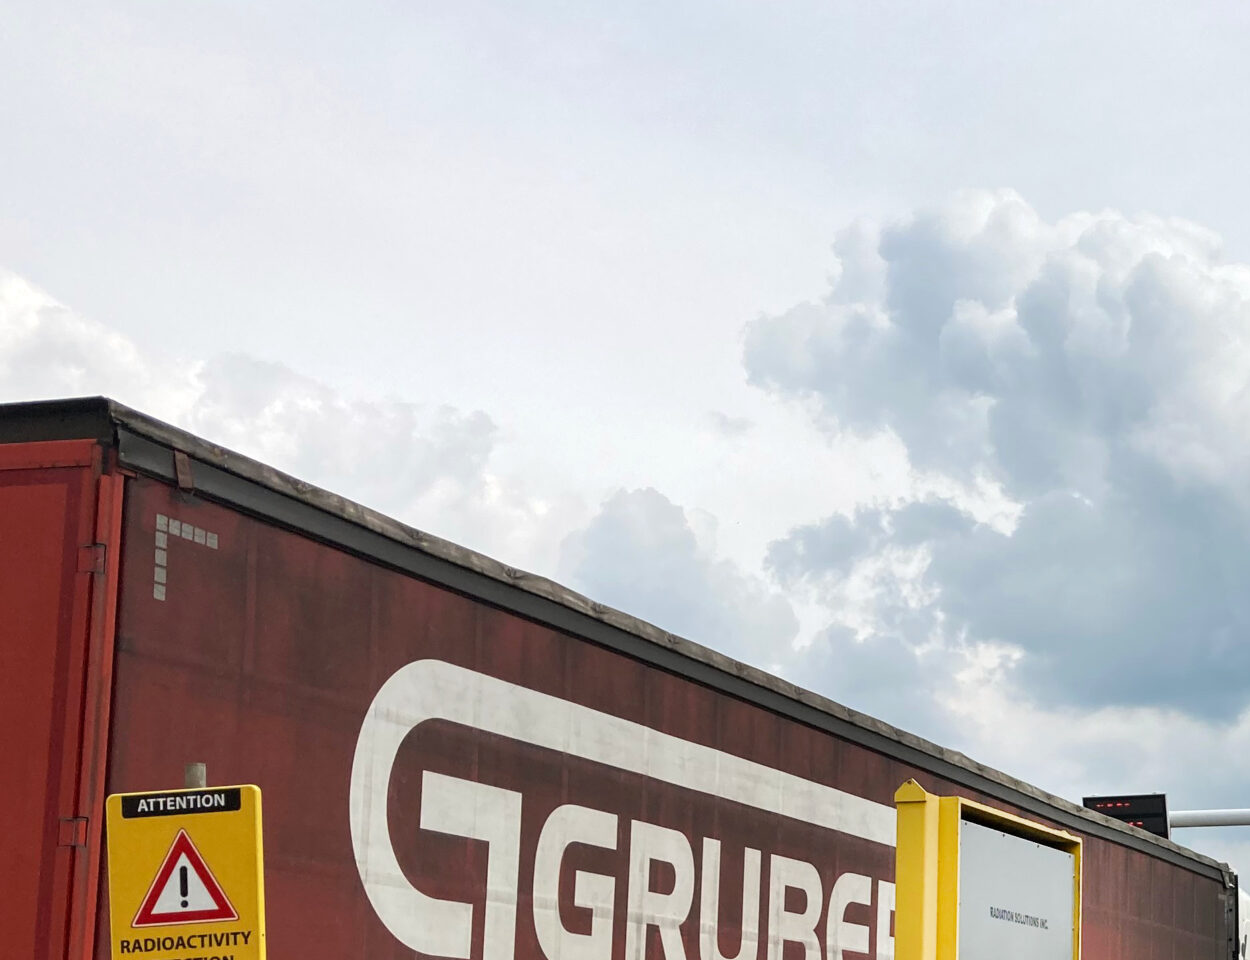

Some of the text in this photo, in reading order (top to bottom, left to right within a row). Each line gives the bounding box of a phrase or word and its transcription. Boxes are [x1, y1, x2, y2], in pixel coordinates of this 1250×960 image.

[137, 793, 226, 813] ATTENTION
[990, 906, 1014, 922] RADIATION
[1014, 912, 1039, 928] SOLUTIONS
[120, 931, 252, 954] RADIOACTIVITY
